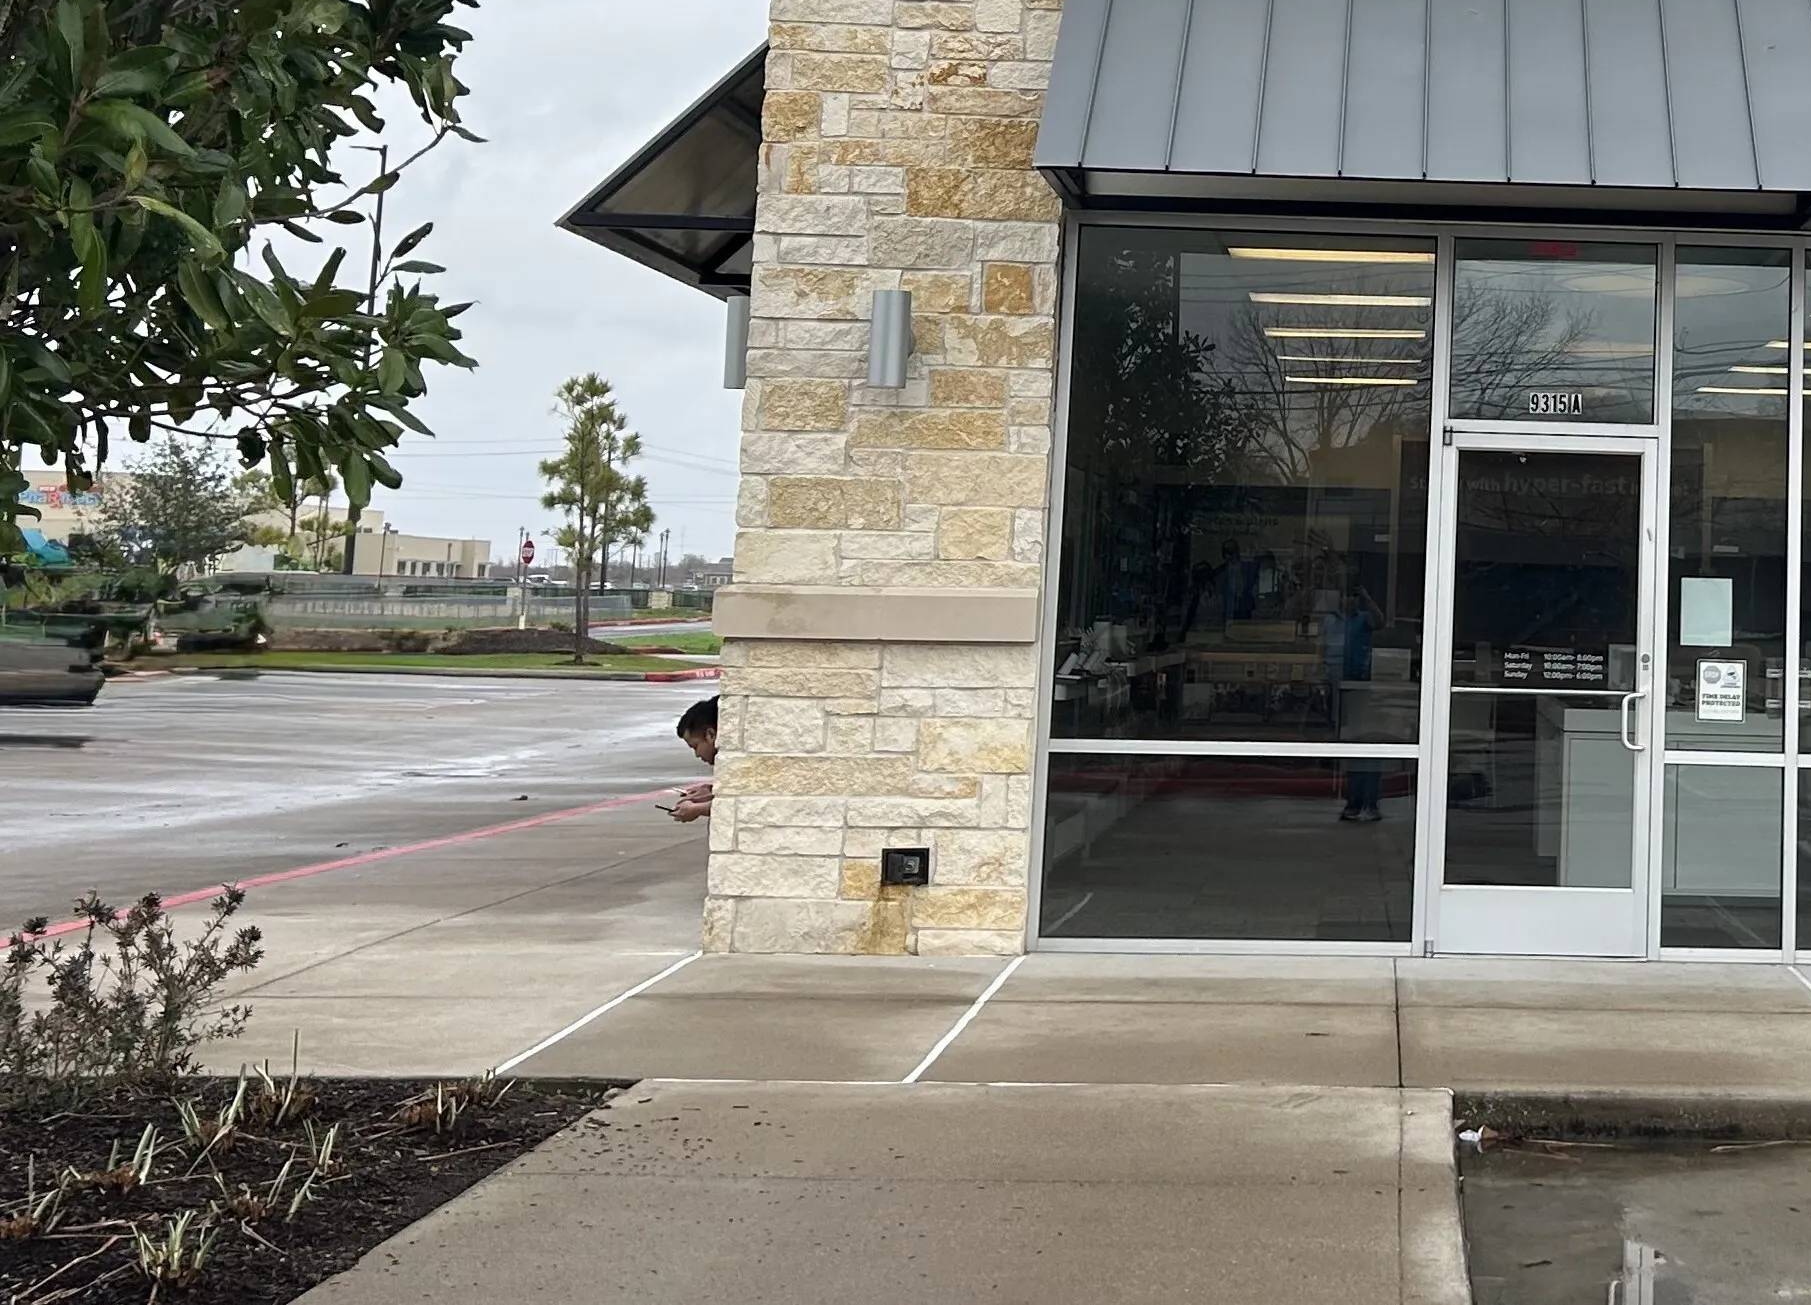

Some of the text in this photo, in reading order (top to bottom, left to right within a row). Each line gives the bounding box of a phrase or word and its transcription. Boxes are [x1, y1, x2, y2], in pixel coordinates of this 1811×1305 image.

[1531, 393, 1582, 414] 9315 A
[1466, 475, 1500, 492] with
[1503, 471, 1627, 495] hyper-fast
